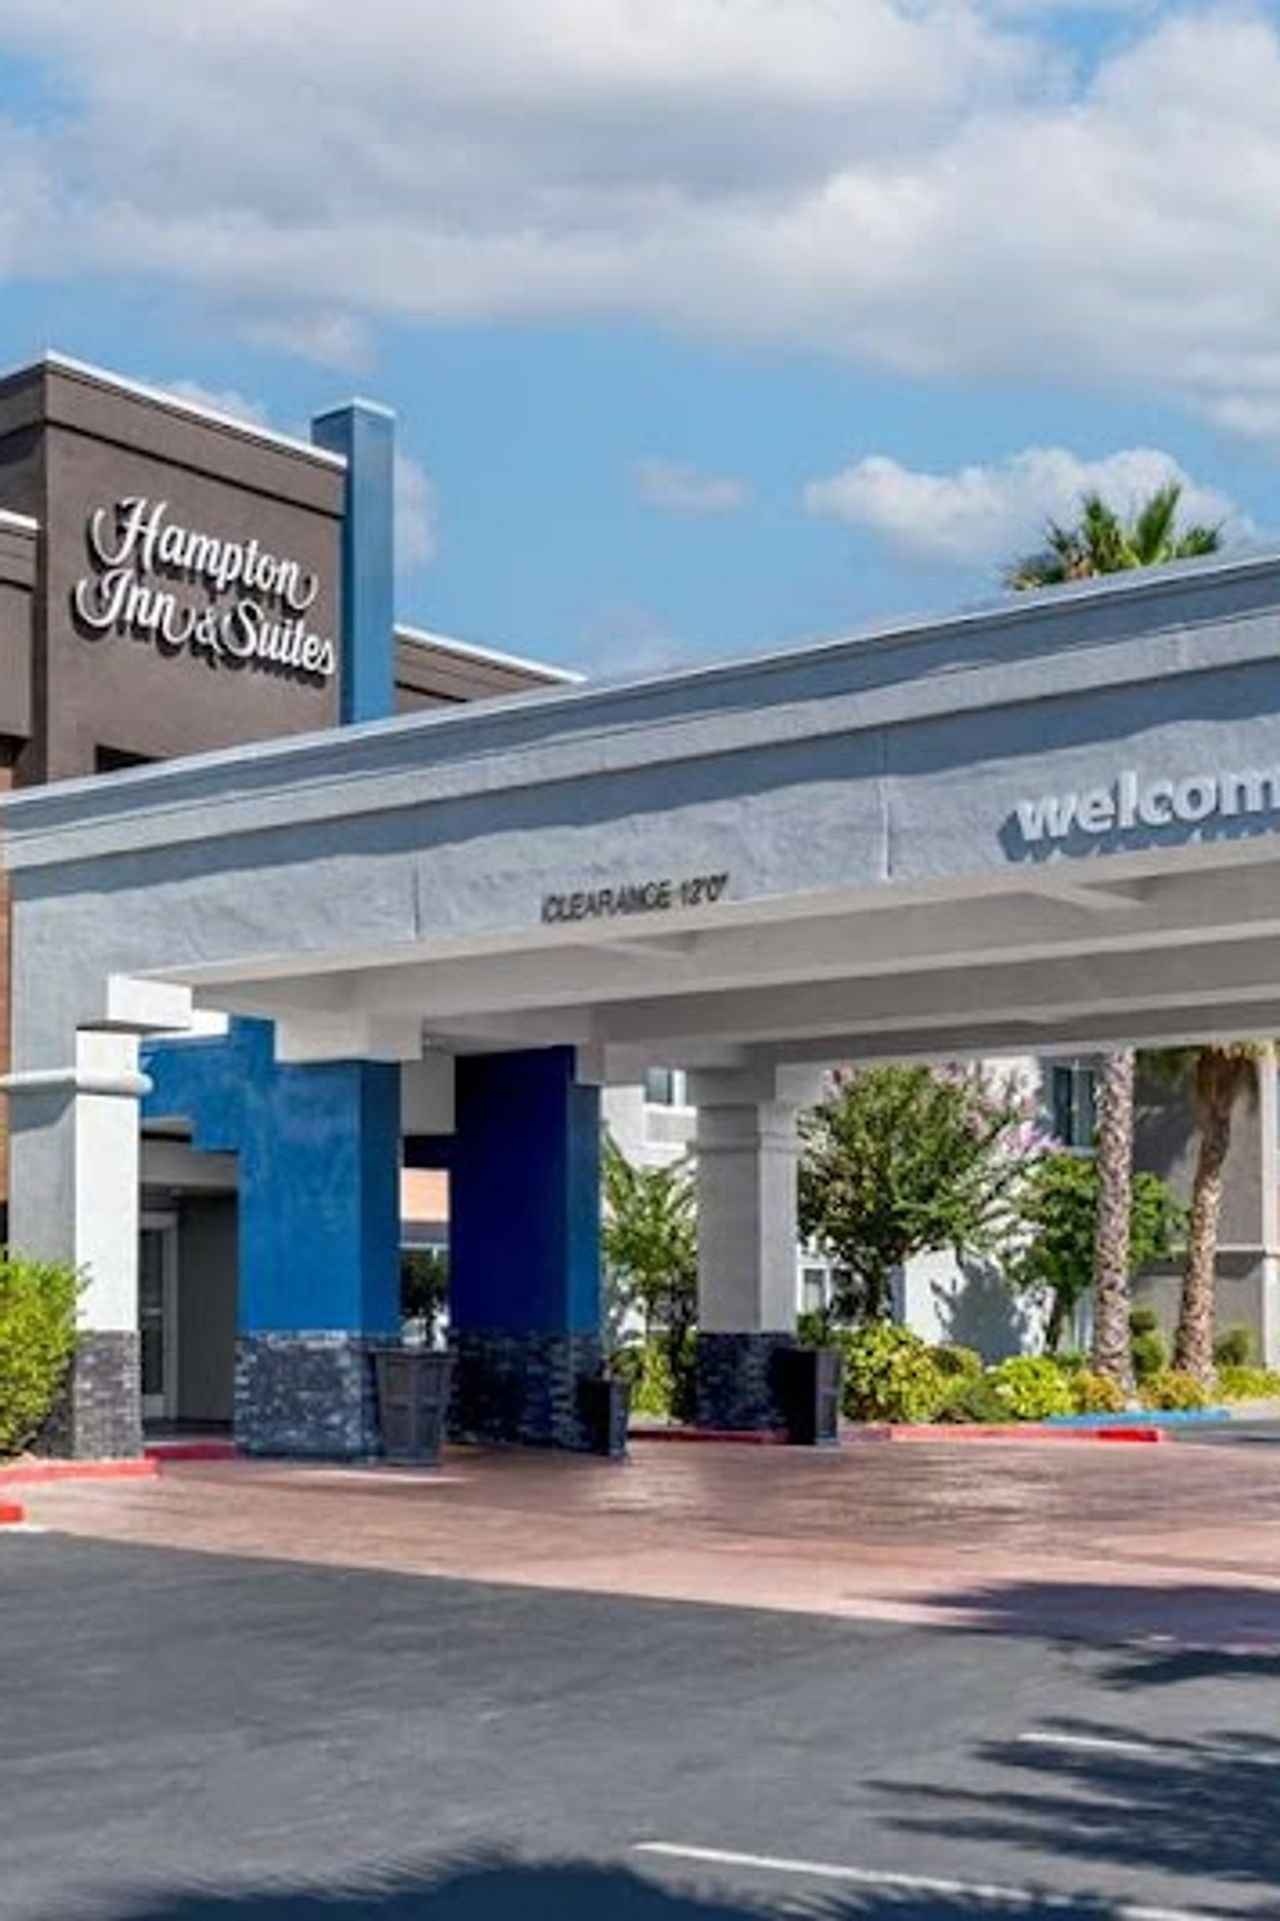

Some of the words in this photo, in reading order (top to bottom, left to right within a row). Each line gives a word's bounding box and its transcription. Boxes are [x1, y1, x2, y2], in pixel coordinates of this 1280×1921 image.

[92, 497, 318, 609] Hampton
[75, 569, 196, 643] Inn
[197, 607, 222, 652] &
[221, 599, 335, 675] Suites
[541, 880, 671, 923] CLEARANCE
